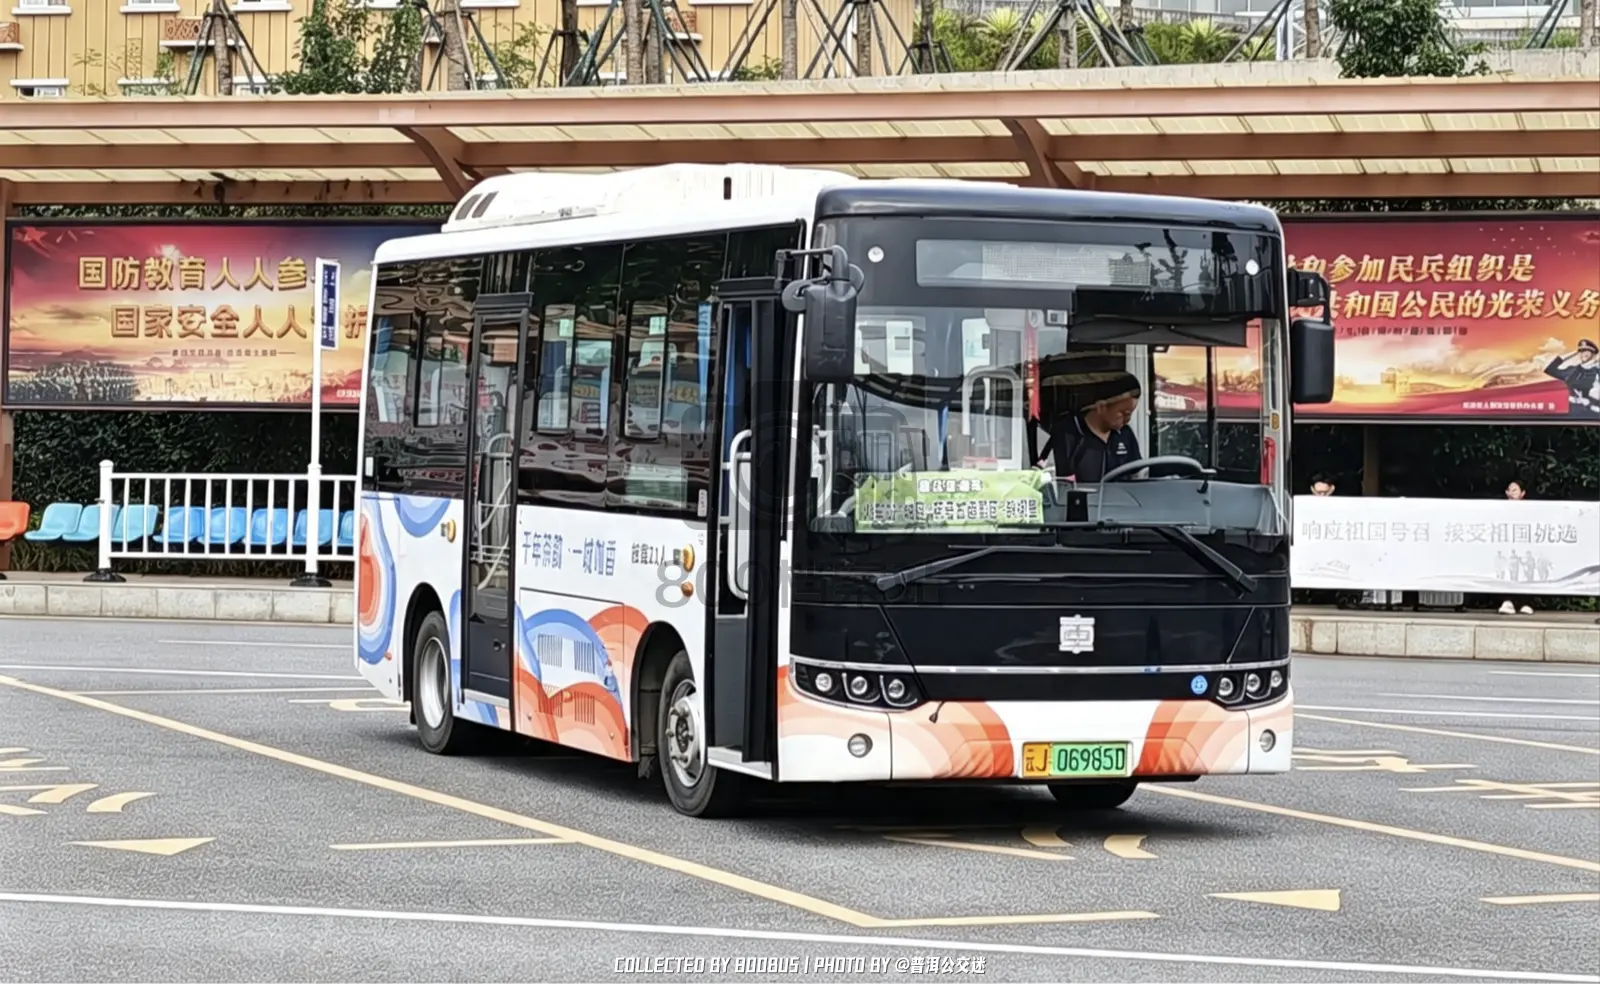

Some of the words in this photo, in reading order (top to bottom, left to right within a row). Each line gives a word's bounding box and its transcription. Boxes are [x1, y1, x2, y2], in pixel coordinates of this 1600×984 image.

[79, 256, 316, 291] 国防教育人人参
[1287, 253, 1536, 283] 和参加民兵组织是
[111, 304, 368, 338] 国家安全人人护
[1301, 520, 1430, 543] 响应祖国号召
[1444, 522, 1578, 543] 接受祖国挑选
